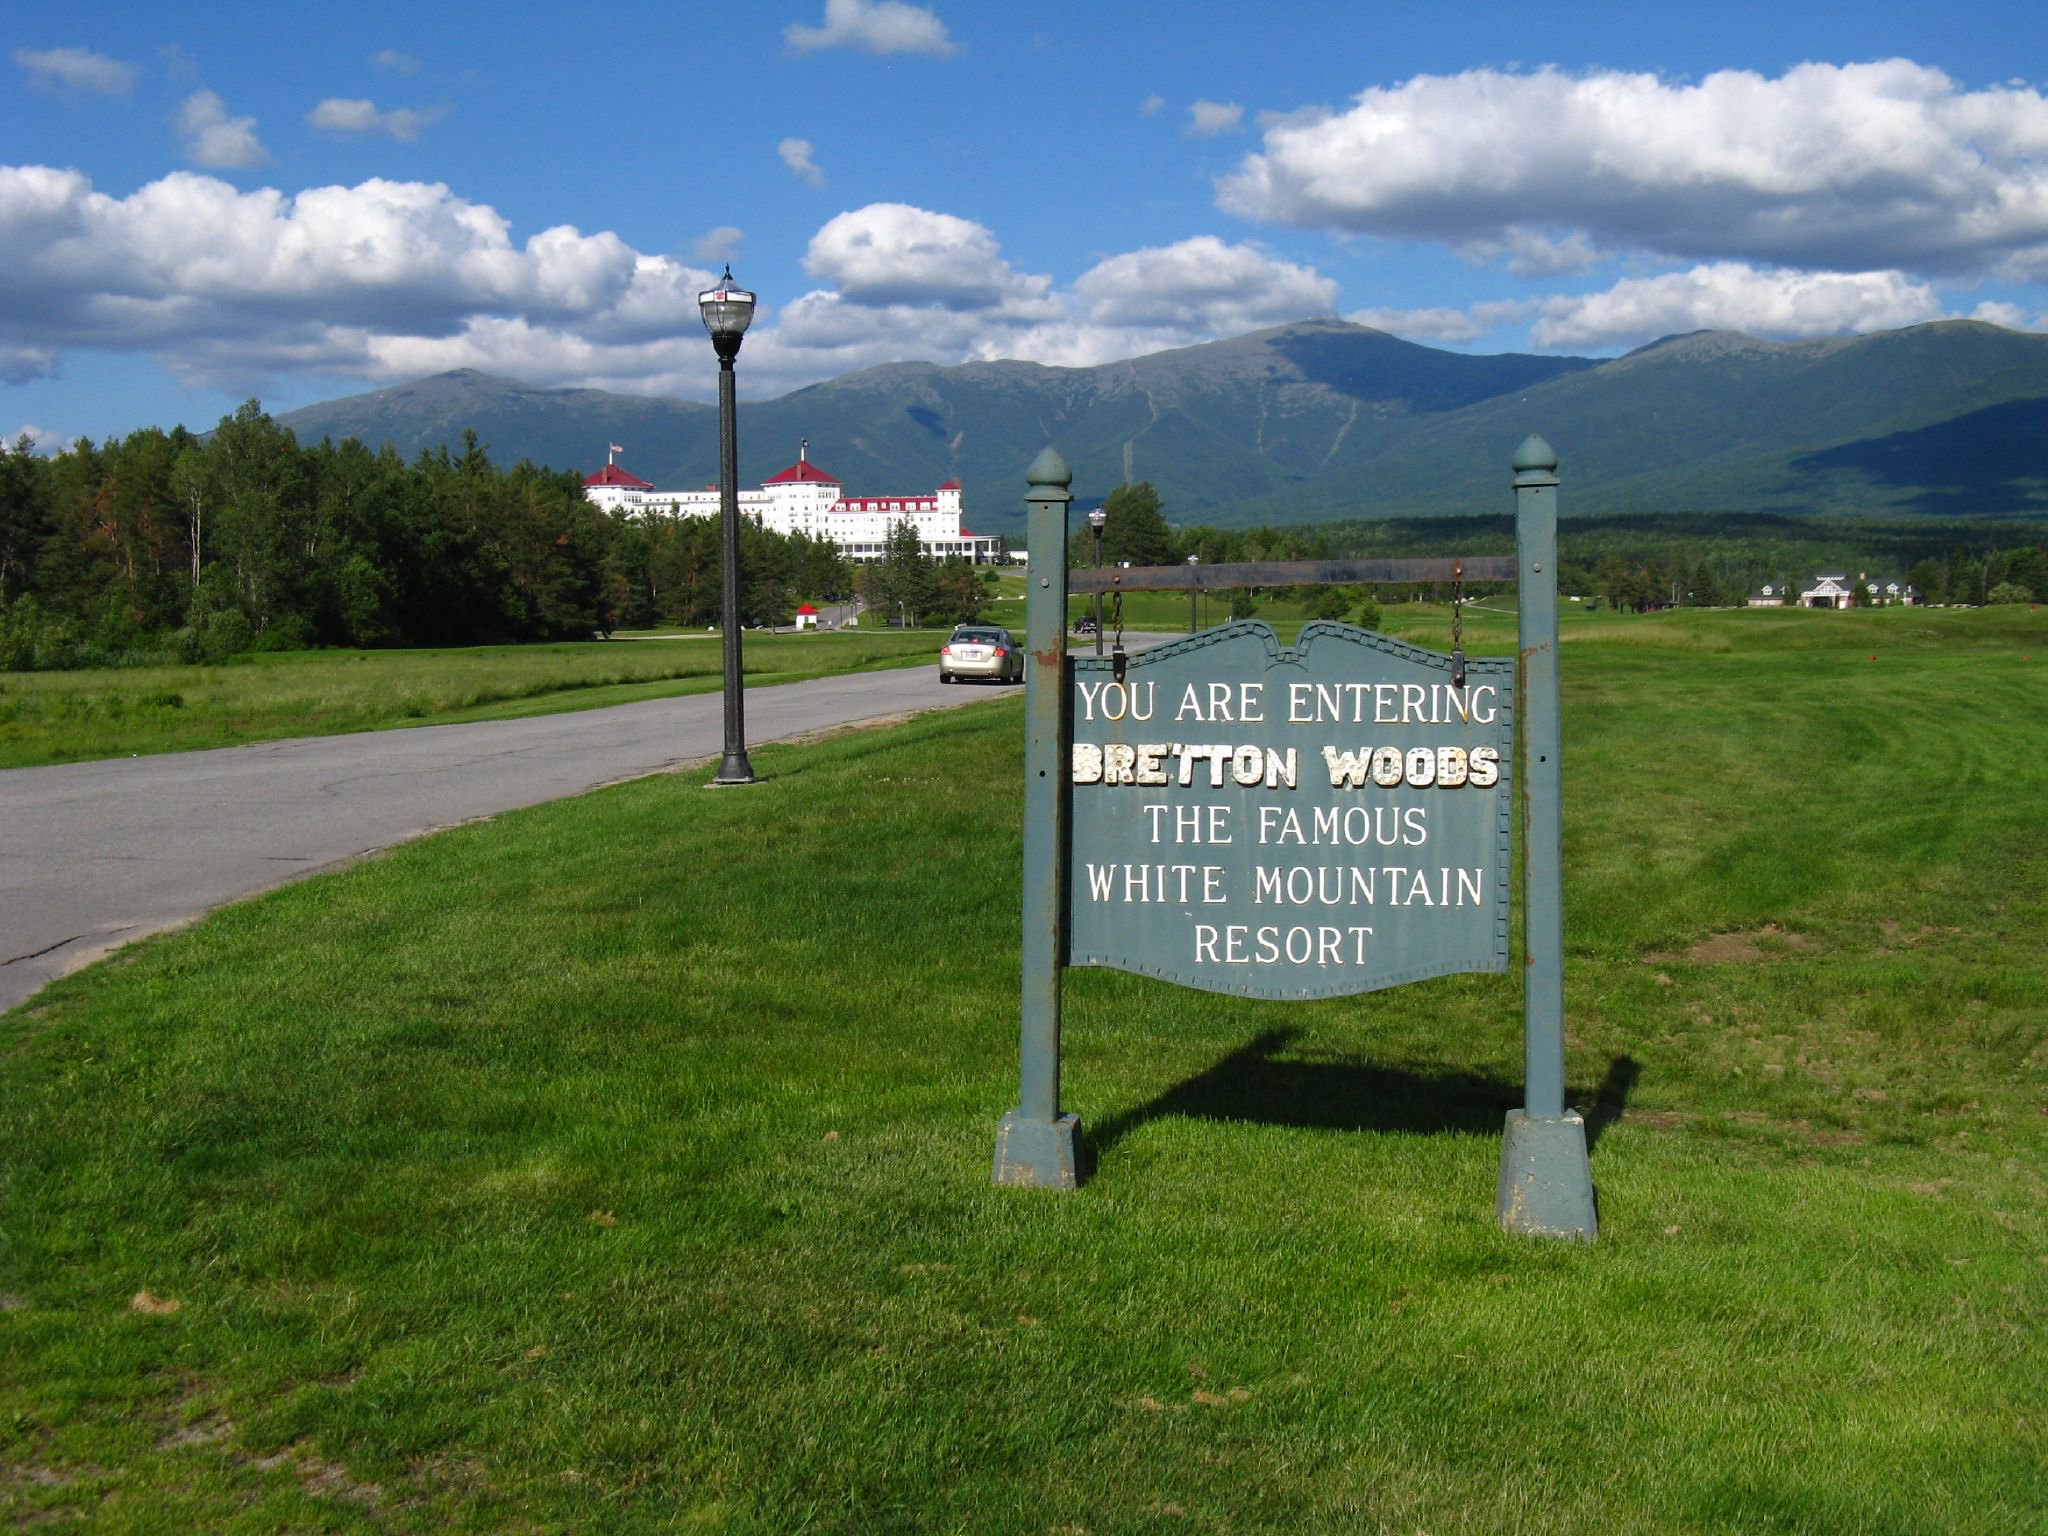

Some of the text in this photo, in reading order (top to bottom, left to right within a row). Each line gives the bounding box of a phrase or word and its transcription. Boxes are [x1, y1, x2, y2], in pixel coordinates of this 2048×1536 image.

[1077, 682, 1497, 724] YOU ARE ENTERING
[1072, 743, 1499, 788] BRETTON WOODS
[1144, 805, 1427, 846] THE FAMOUS
[1086, 864, 1483, 906] WHITE MOUNTAIN
[1195, 926, 1372, 964] RESORT
